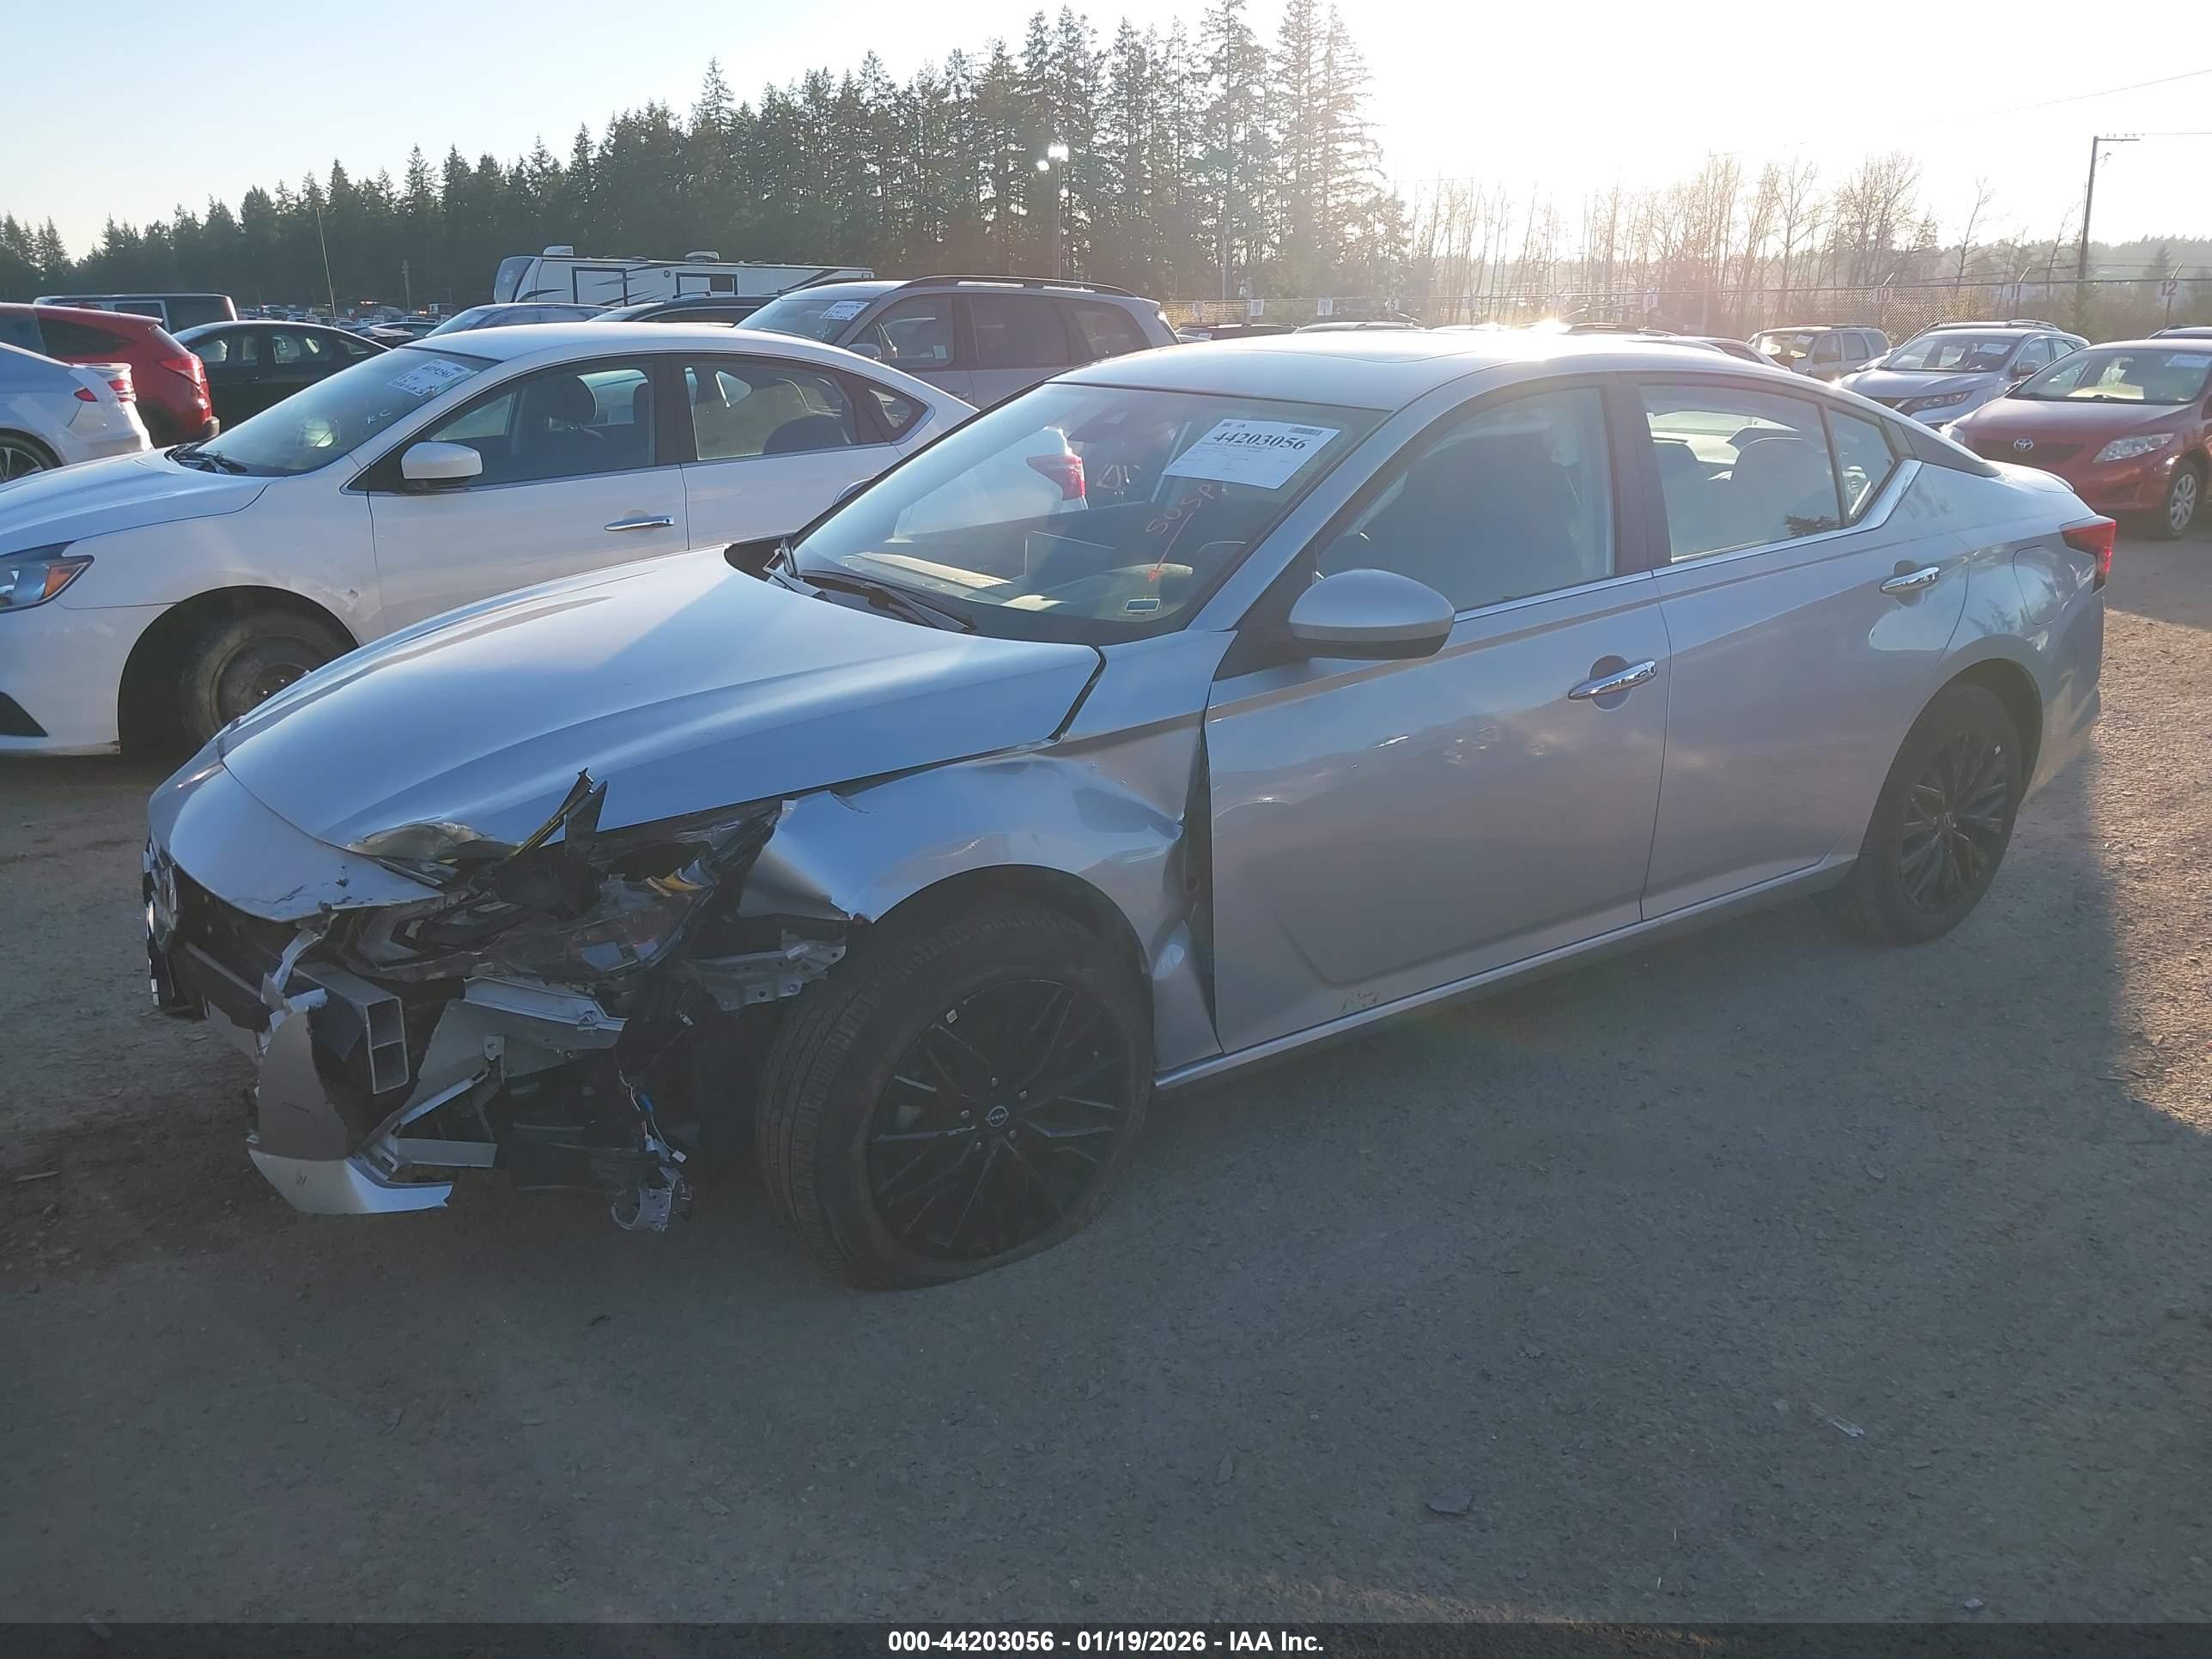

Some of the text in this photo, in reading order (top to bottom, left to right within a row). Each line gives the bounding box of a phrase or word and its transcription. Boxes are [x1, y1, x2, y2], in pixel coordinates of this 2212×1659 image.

[1876, 289, 1889, 301] 10
[2011, 284, 2021, 298] 11
[2161, 281, 2179, 296] 12
[1757, 292, 1765, 305] 9
[1213, 431, 1310, 451] 44203056
